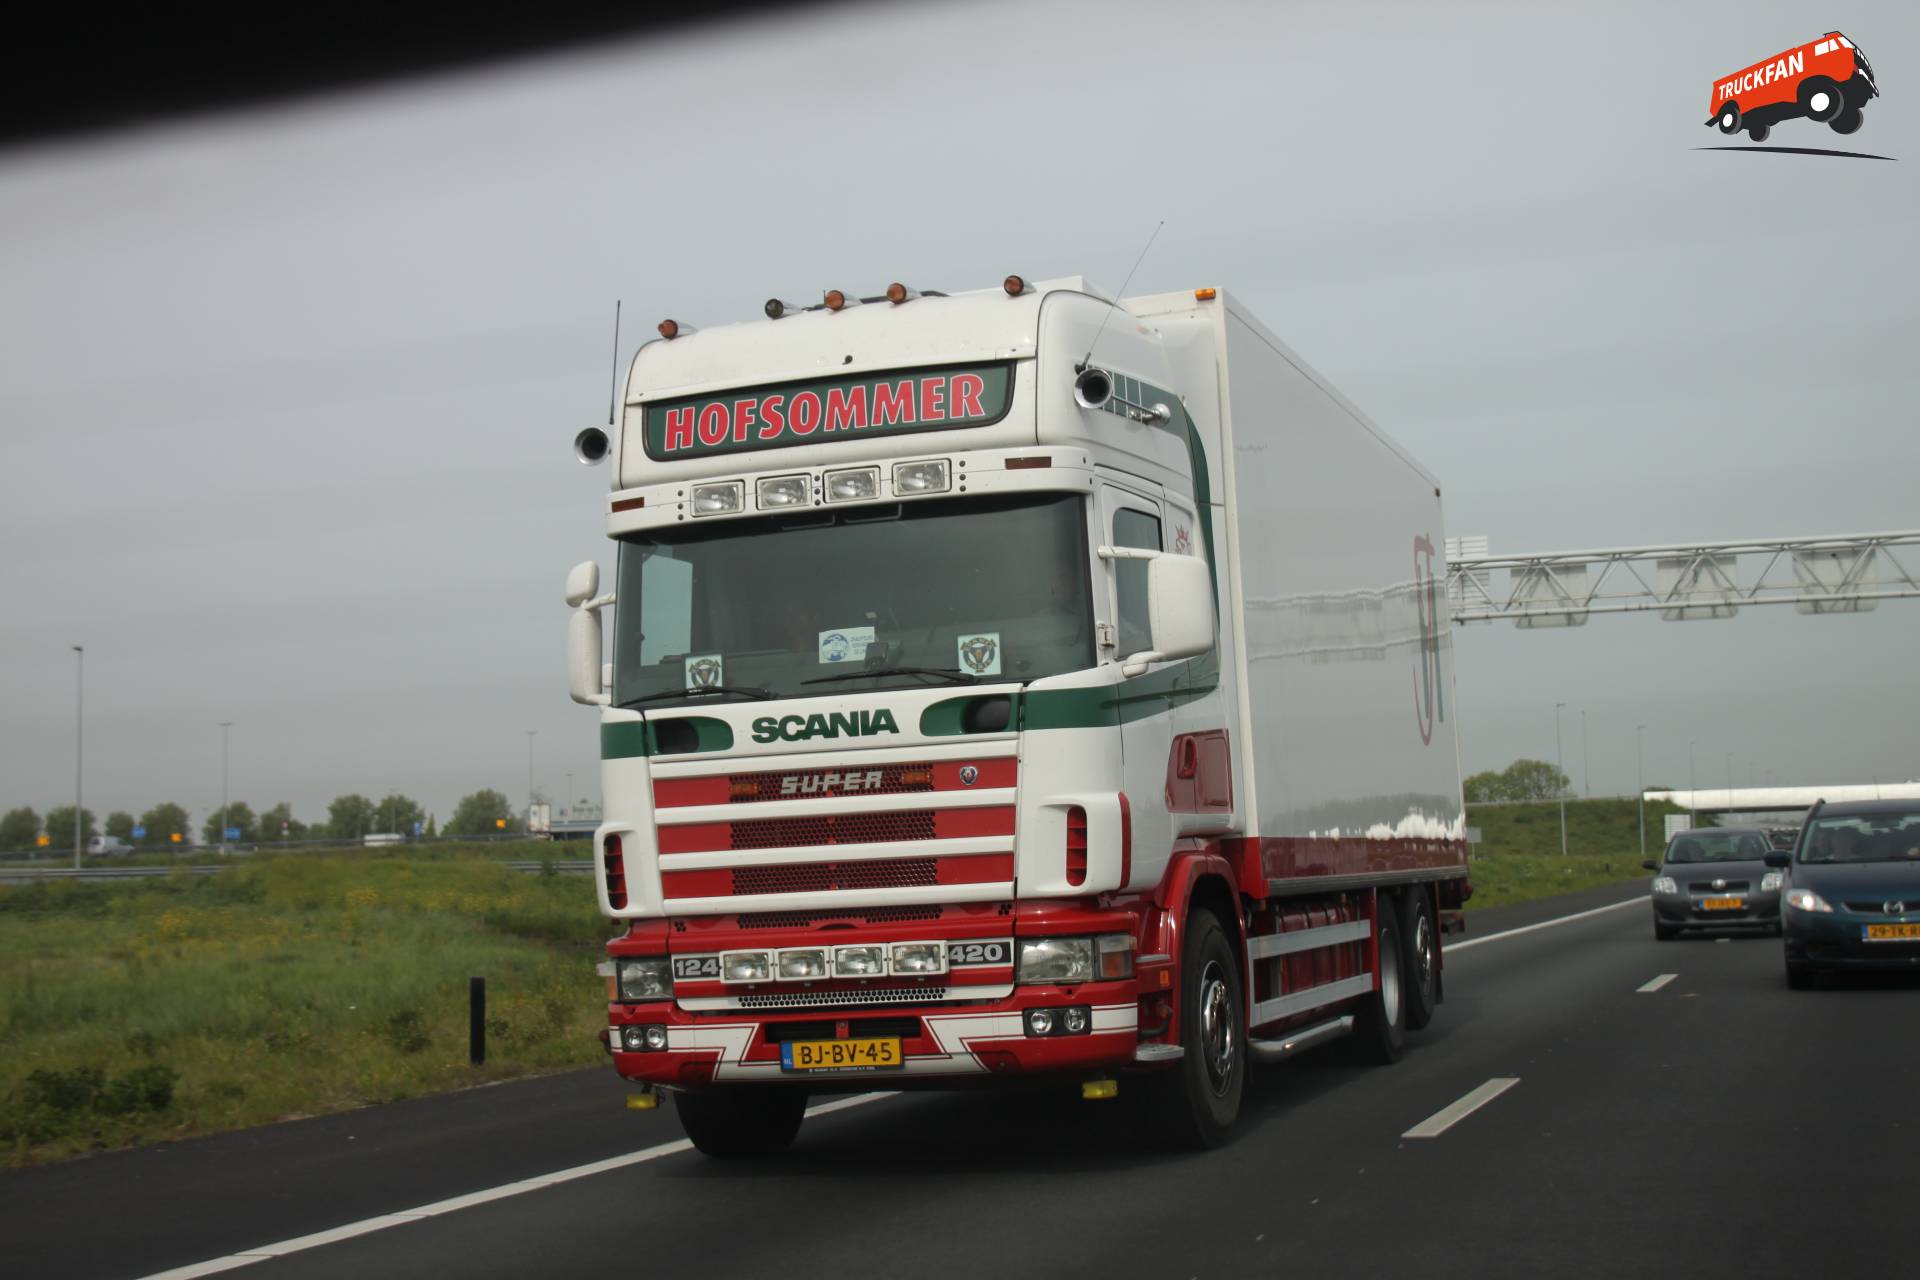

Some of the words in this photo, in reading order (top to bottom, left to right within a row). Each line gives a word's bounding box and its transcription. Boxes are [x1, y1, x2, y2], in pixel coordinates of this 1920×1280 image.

[664, 373, 985, 452] HOFSOMMER
[752, 708, 900, 744] SCANIA
[780, 771, 882, 794] SUPER
[949, 943, 1003, 962] 420
[676, 958, 719, 977] 124
[800, 1042, 892, 1065] BJ-BV-45
